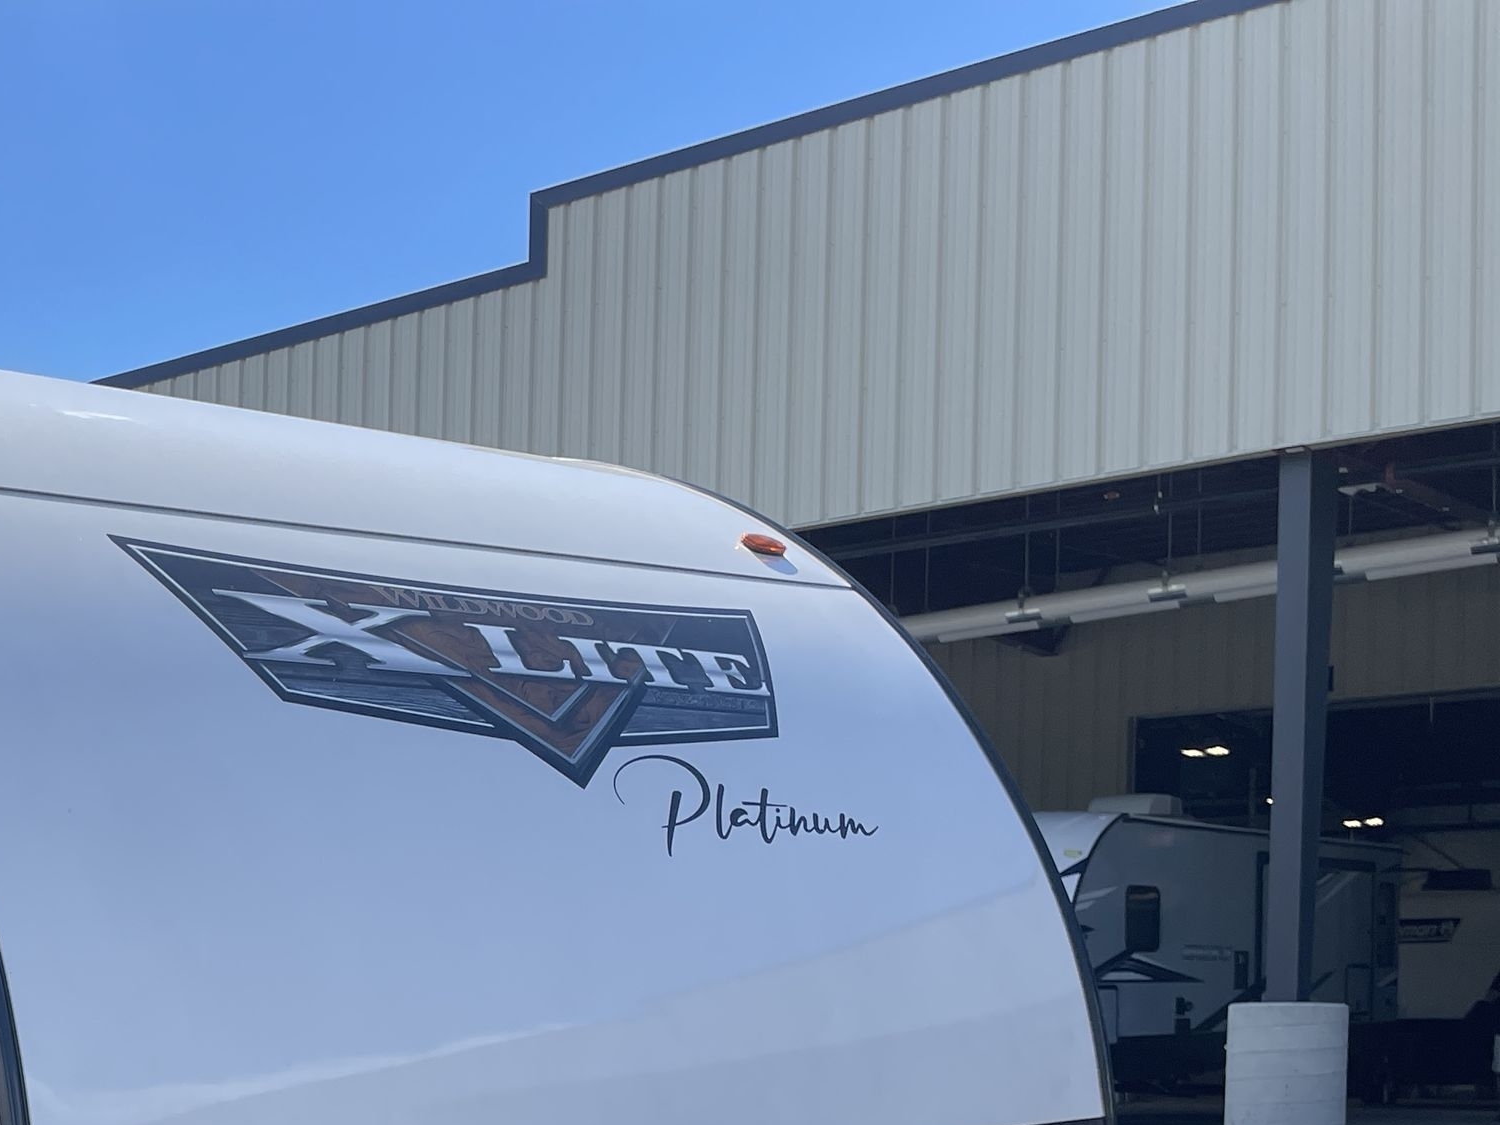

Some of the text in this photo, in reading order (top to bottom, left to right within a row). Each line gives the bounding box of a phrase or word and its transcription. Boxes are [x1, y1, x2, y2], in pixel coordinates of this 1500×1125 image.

[211, 588, 772, 698] X LITE
[369, 585, 595, 626] WILDWOOD
[613, 754, 879, 858] Platinum
